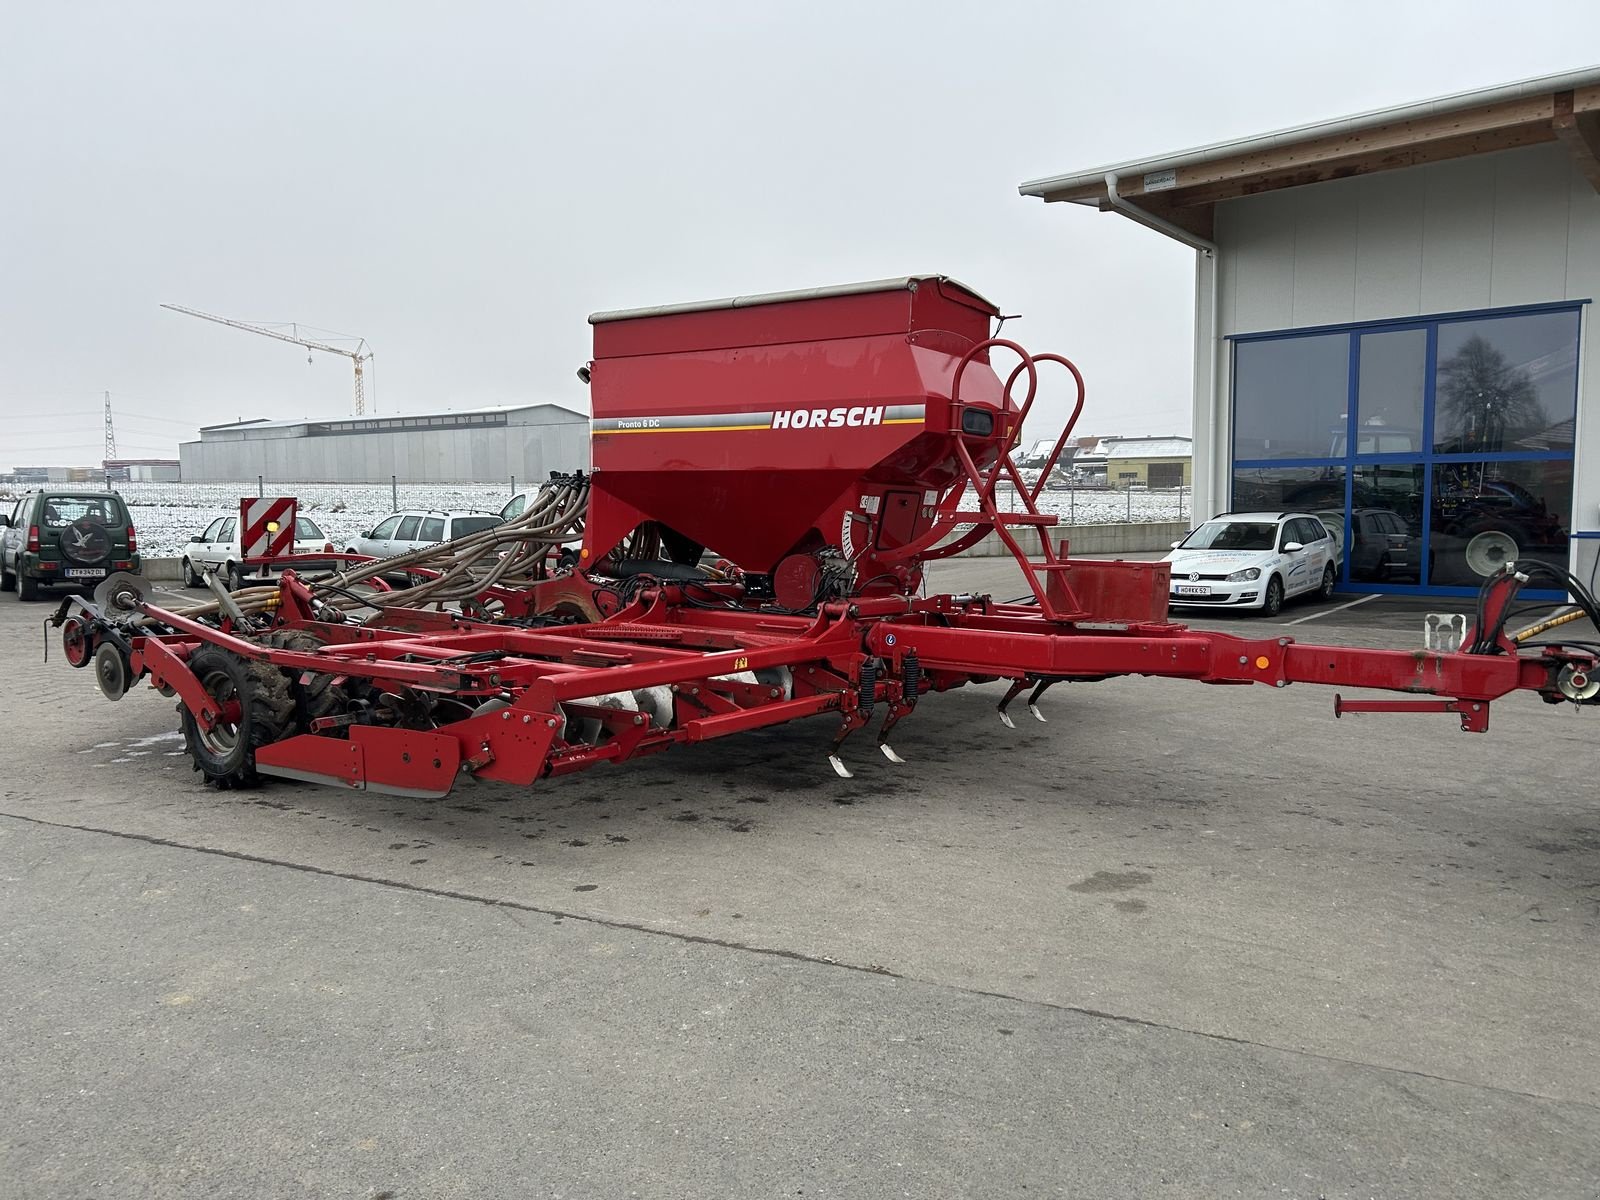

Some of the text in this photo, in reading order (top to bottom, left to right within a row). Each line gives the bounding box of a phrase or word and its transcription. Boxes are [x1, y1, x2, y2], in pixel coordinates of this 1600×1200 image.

[618, 419, 660, 429] Pronto 6 DC
[772, 405, 884, 430] HORSCH
